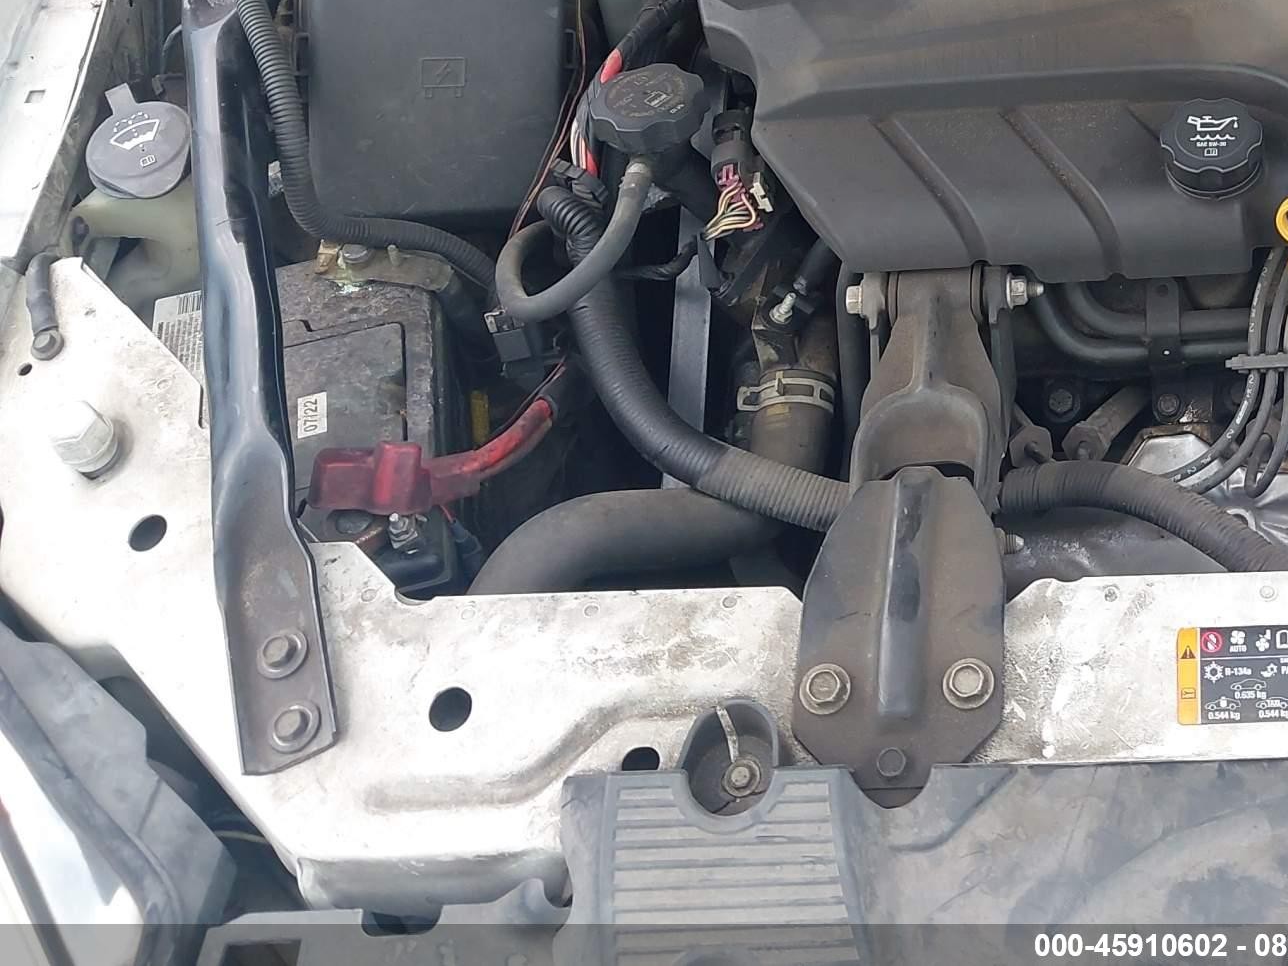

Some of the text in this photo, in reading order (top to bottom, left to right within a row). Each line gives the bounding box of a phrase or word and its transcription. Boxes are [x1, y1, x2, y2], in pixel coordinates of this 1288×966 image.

[1229, 645, 1247, 653] AUTO
[1225, 667, 1252, 676] R-134a
[1234, 690, 1267, 700] 0.635 kg
[1208, 710, 1241, 720] 0.544 kg
[1258, 709, 1279, 719] 0.544
